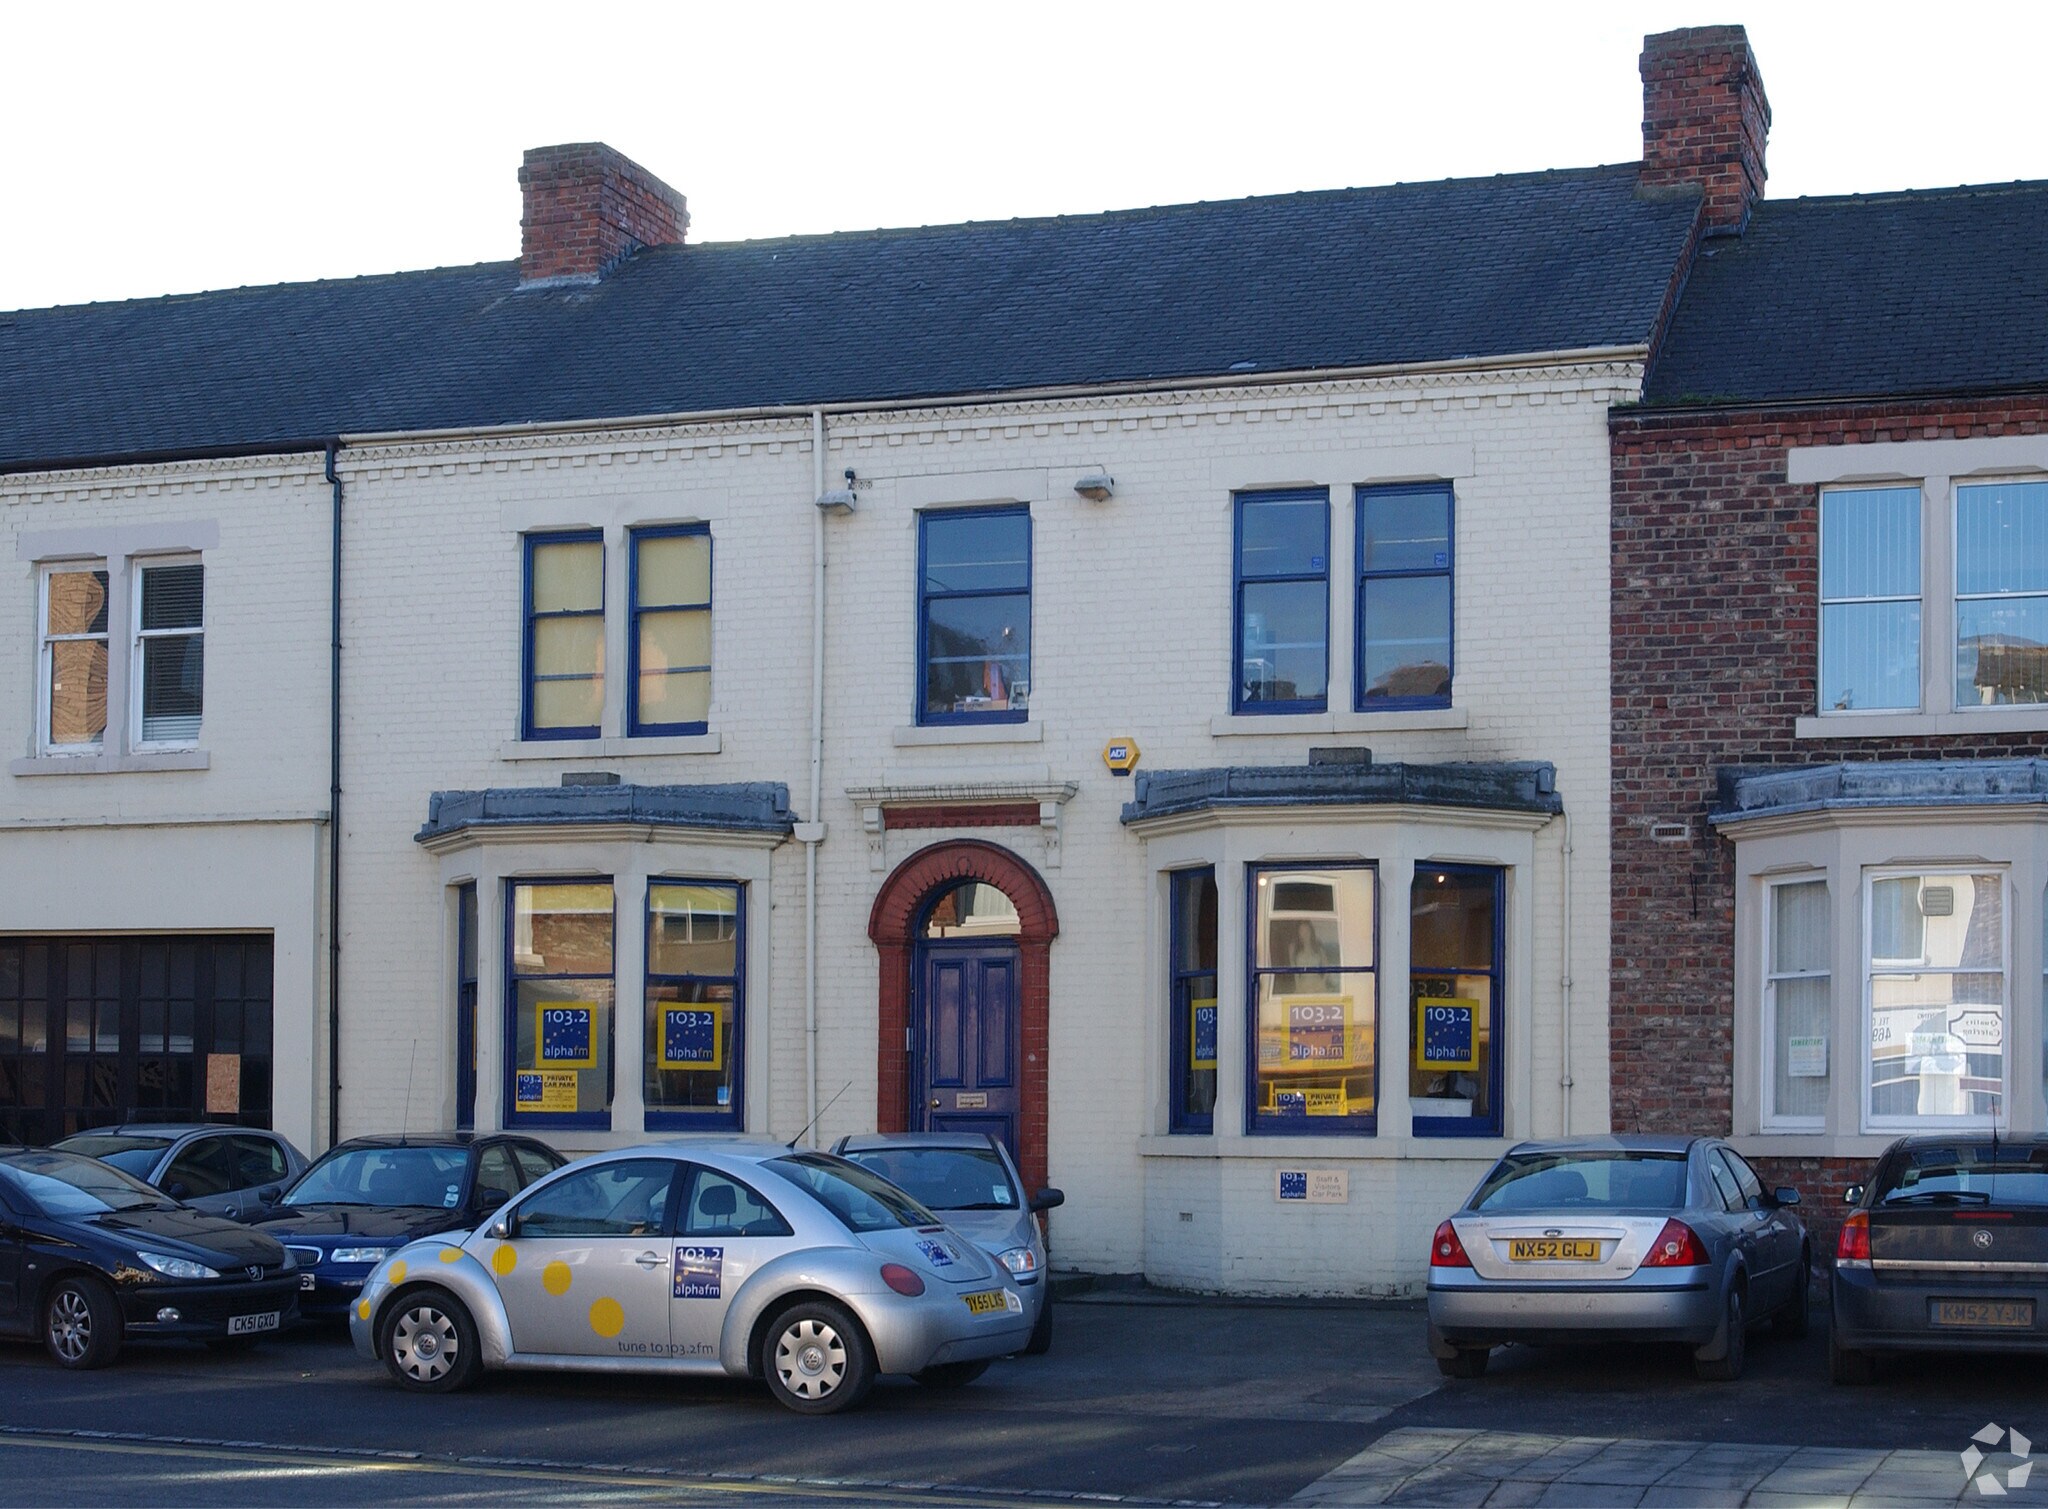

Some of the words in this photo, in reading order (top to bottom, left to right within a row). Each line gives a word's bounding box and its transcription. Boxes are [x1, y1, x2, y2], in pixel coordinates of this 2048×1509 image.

[1110, 749, 1126, 758] ADT
[545, 1010, 588, 1026] 103.2
[667, 1011, 713, 1027] 103.2
[1291, 1006, 1343, 1023] 103.2
[1427, 1007, 1471, 1024] 103.2
[544, 1045, 588, 1058] alphafm
[667, 1046, 713, 1060] alphafm
[1291, 1044, 1343, 1058] alphafm
[1426, 1045, 1470, 1059] alphafm
[519, 1075, 542, 1084] 103.2
[1282, 1172, 1306, 1182] 103.2
[677, 1247, 721, 1263] 103.2
[1515, 1241, 1559, 1257] NX52
[1562, 1241, 1595, 1257] GLJ
[675, 1283, 719, 1297] alphafm
[618, 1341, 647, 1352] tune
[651, 1341, 663, 1352] to
[665, 1342, 713, 1355] 103.2fm
